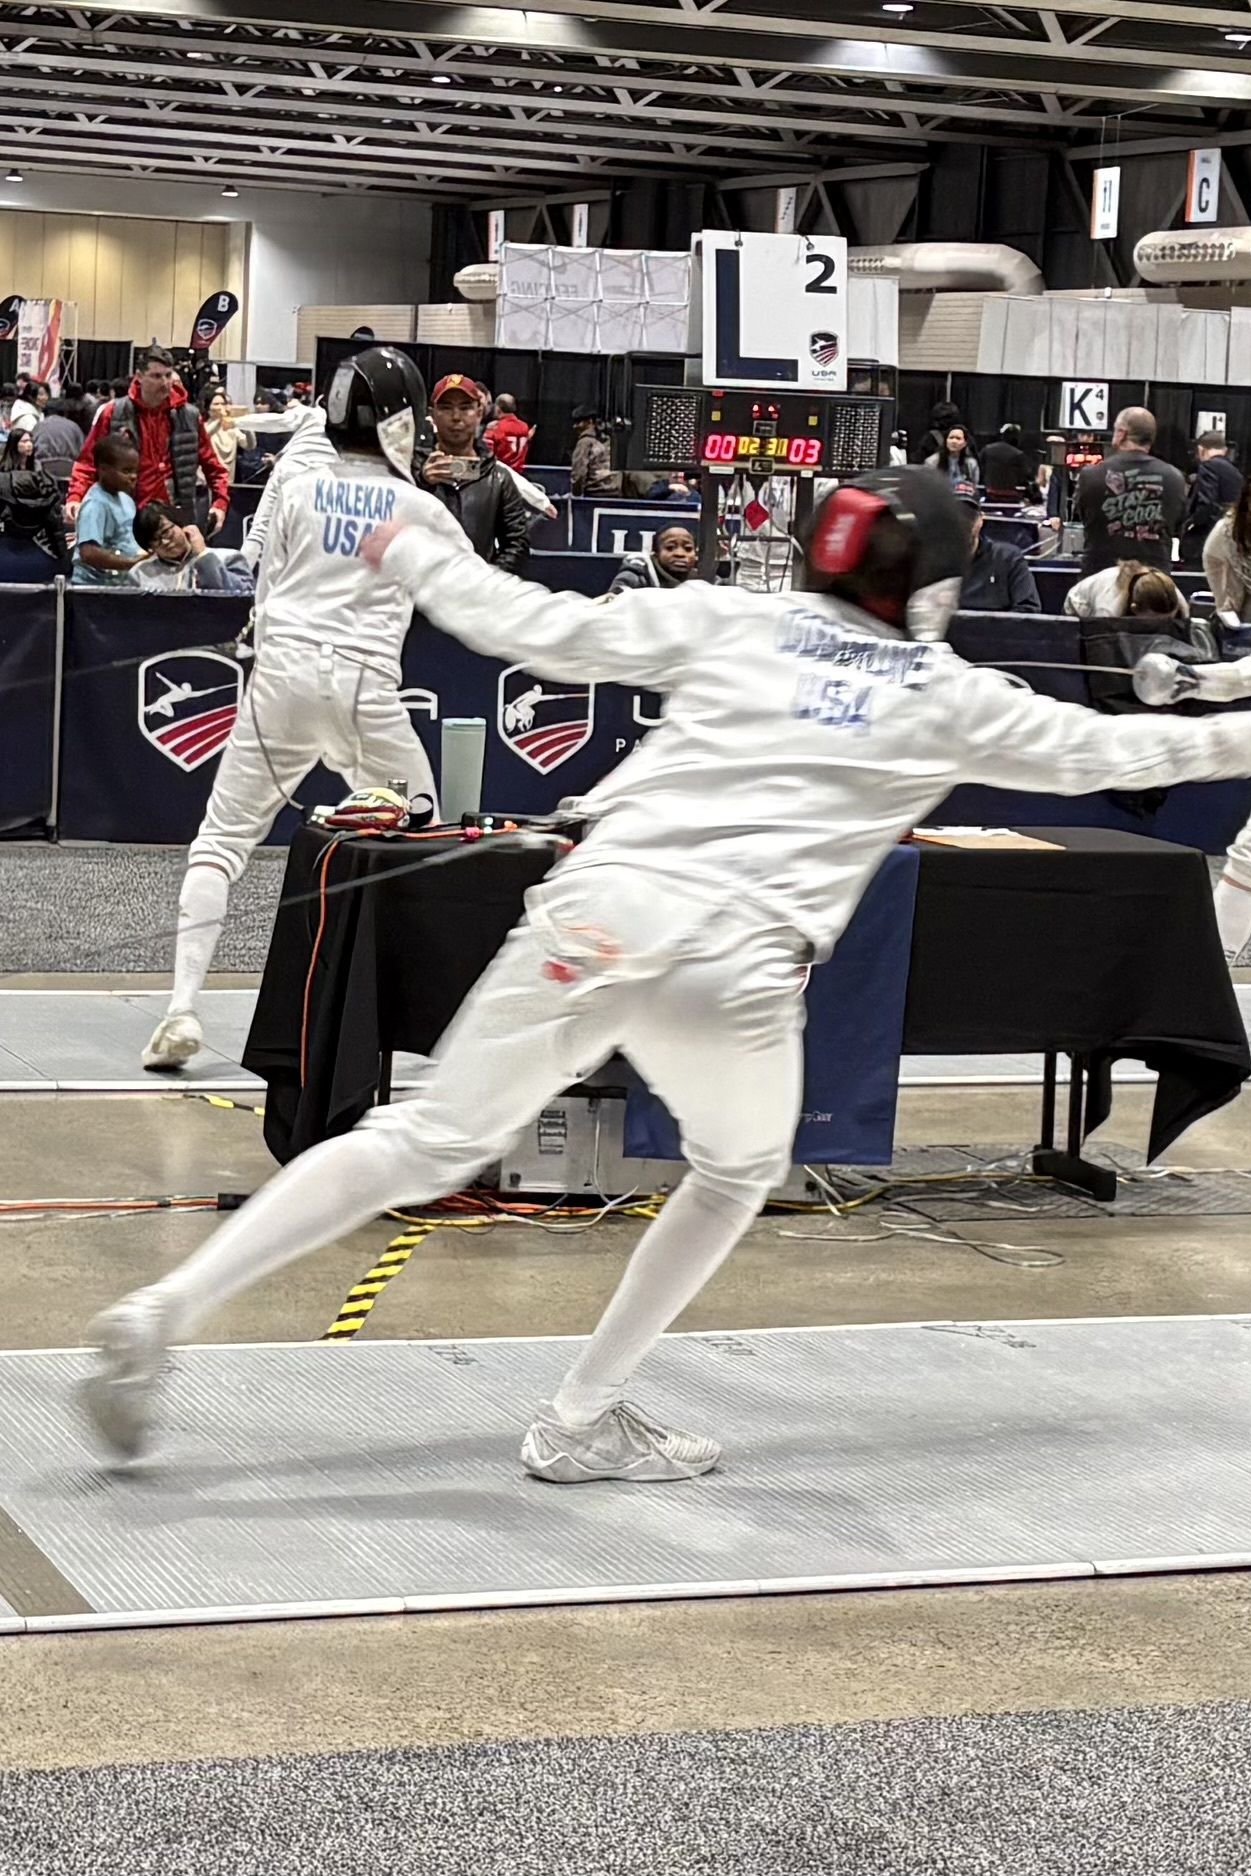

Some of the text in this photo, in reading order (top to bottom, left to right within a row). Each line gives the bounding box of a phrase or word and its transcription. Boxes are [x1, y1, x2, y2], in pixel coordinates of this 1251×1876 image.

[1198, 177, 1210, 213] C
[805, 253, 837, 294] 2
[217, 295, 230, 312] B
[715, 248, 798, 382] L
[1068, 387, 1093, 427] K
[1095, 388, 1105, 401] 4
[705, 434, 736, 459] 00
[789, 439, 821, 464] 03
[314, 478, 396, 521] KARLEKAR
[1102, 489, 1147, 519] STAY
